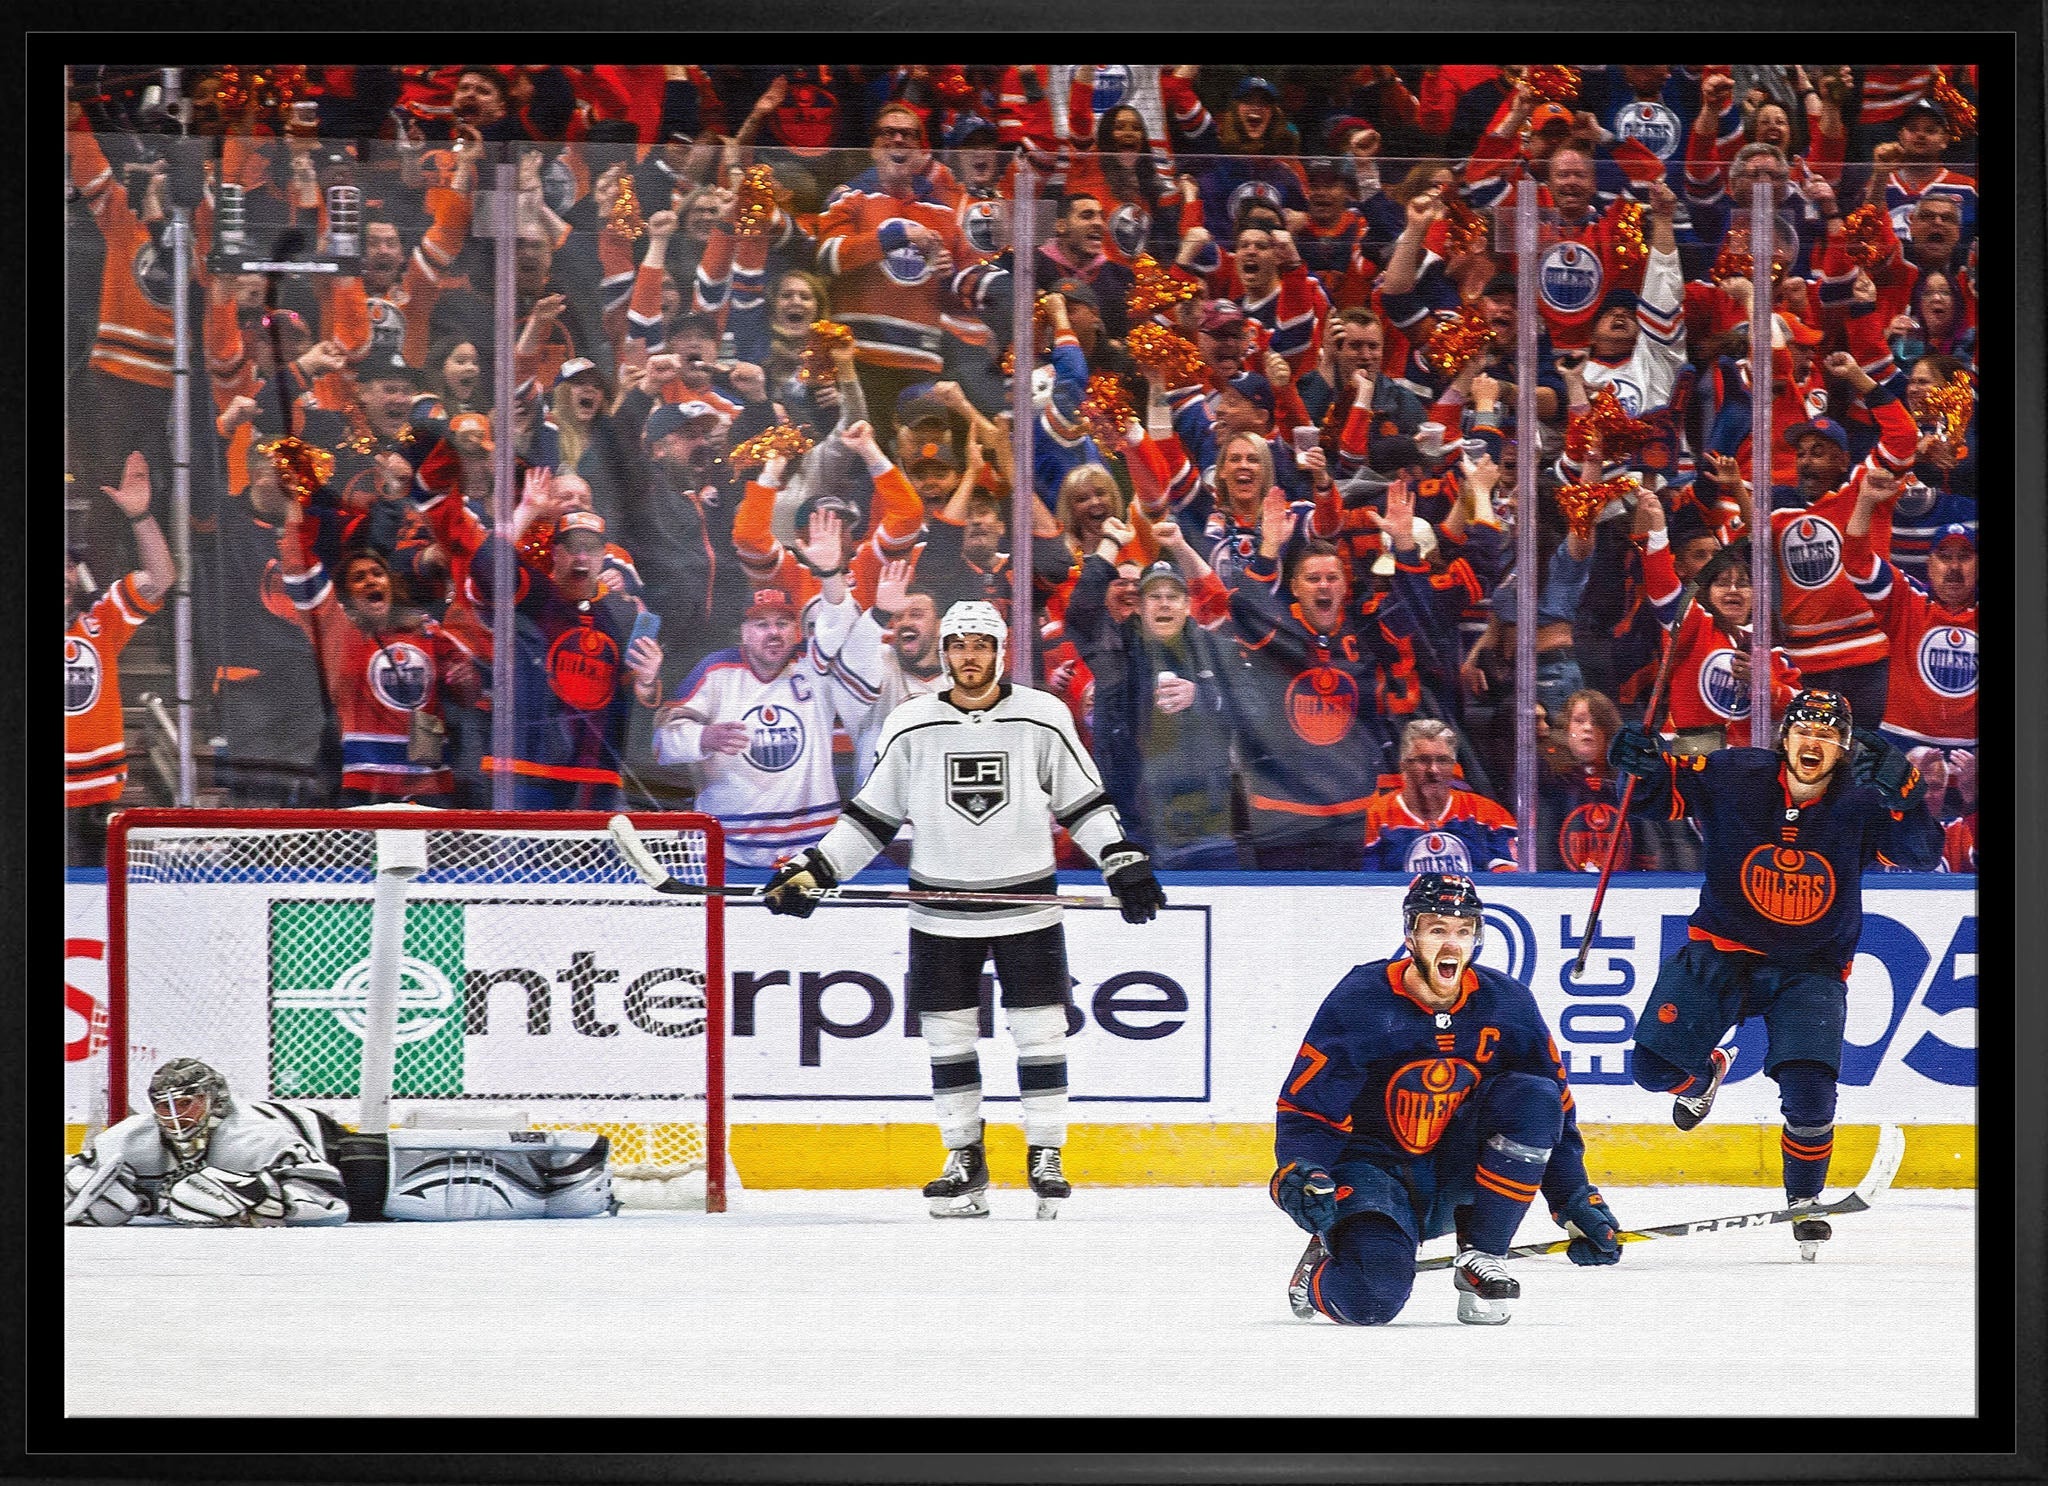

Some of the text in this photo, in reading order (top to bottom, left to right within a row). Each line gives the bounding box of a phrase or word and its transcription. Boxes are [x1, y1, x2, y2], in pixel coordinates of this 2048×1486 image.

[1341, 634, 1360, 663] C
[789, 673, 812, 702] C
[953, 761, 1001, 782] LA
[1751, 864, 1826, 910] OILERS
[328, 951, 1189, 1067] enterpie
[1560, 914, 1636, 1086] EOCF
[1475, 1026, 1501, 1063] C
[1288, 1042, 1330, 1096] 7
[1395, 1085, 1471, 1132] OILER
[1686, 1211, 1773, 1236] CCM
